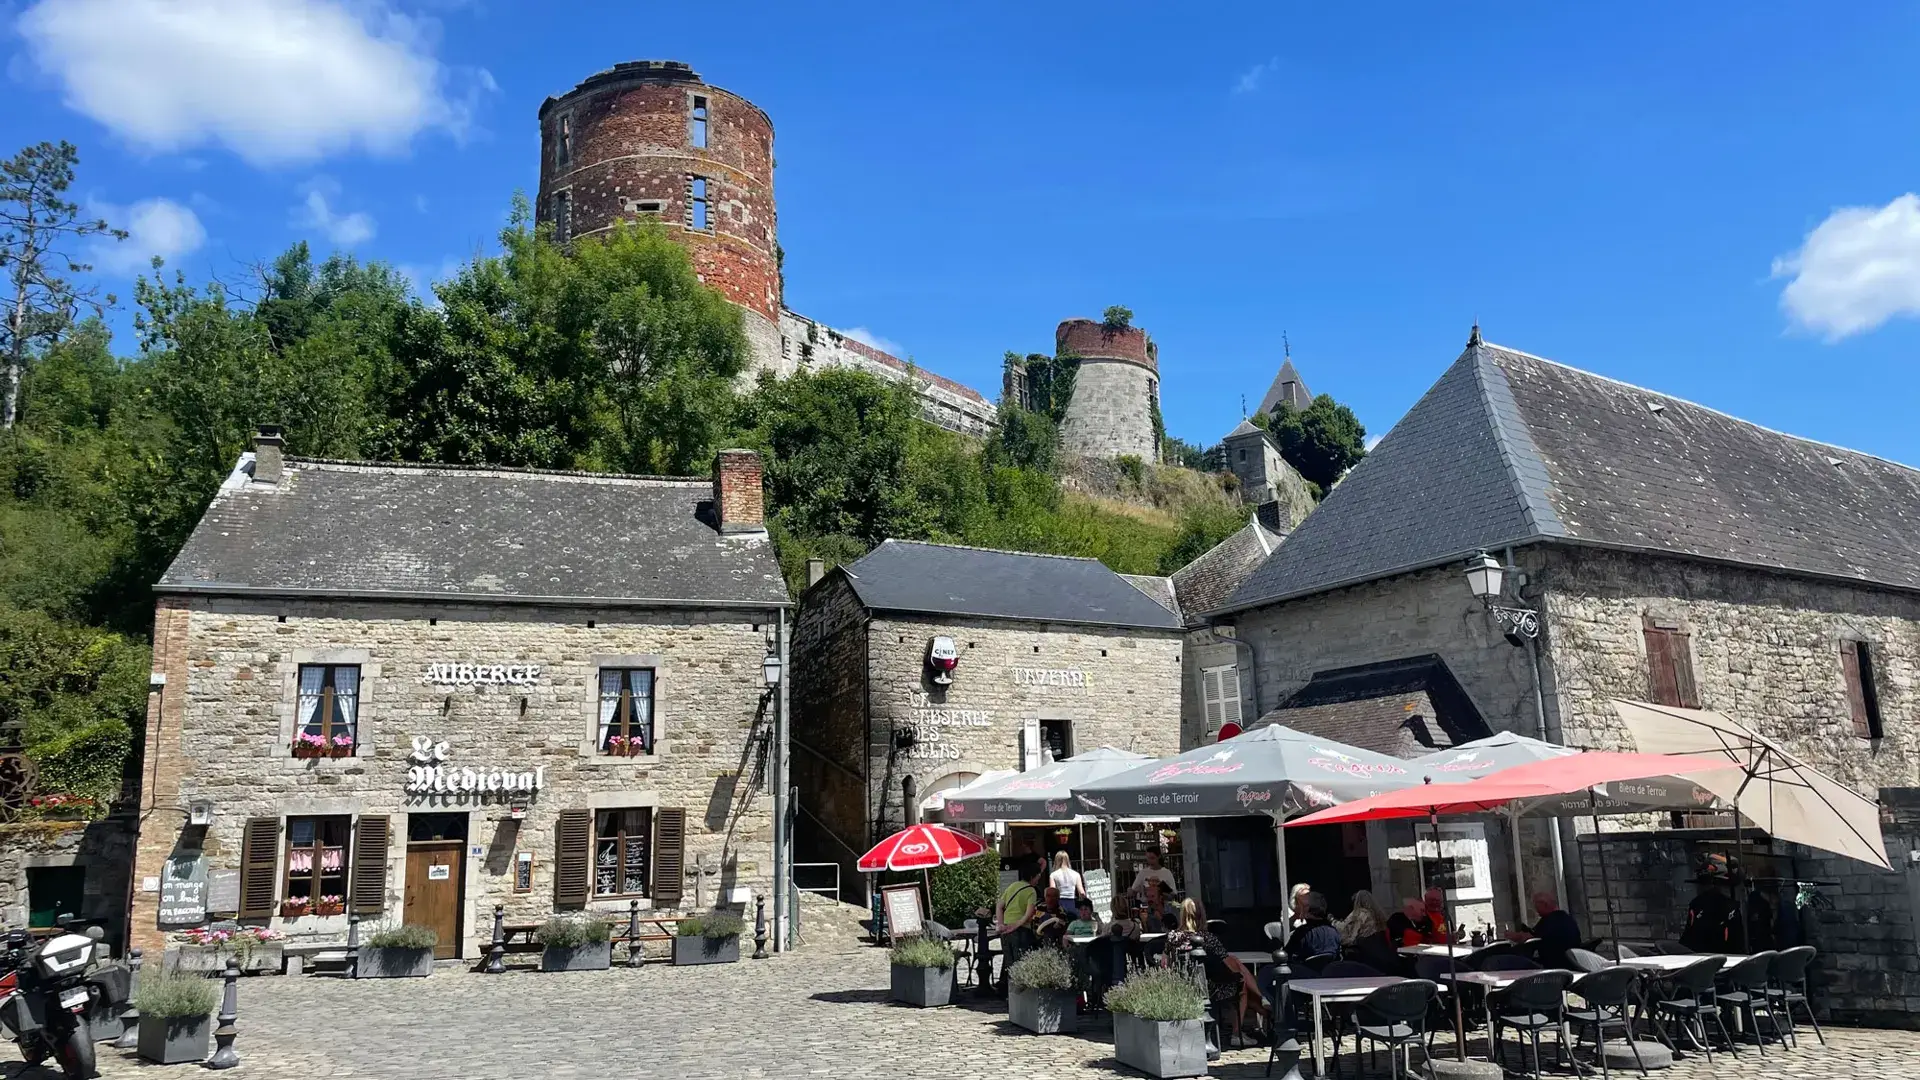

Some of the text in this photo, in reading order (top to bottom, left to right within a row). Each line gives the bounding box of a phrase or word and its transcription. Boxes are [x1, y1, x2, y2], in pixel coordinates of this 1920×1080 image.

[422, 662, 541, 688] AUBERGE
[1011, 667, 1094, 687] TAVERNE
[909, 691, 930, 708] LA
[409, 735, 450, 762] Le
[406, 765, 547, 792] Médiéval
[1618, 782, 1667, 797] Bière de Terroir
[1138, 792, 1199, 805] Bière de Terroir
[1005, 803, 1022, 812] Terroir
[175, 882, 204, 894] mange
[178, 891, 200, 903] boit
[160, 905, 206, 916] on raconte
